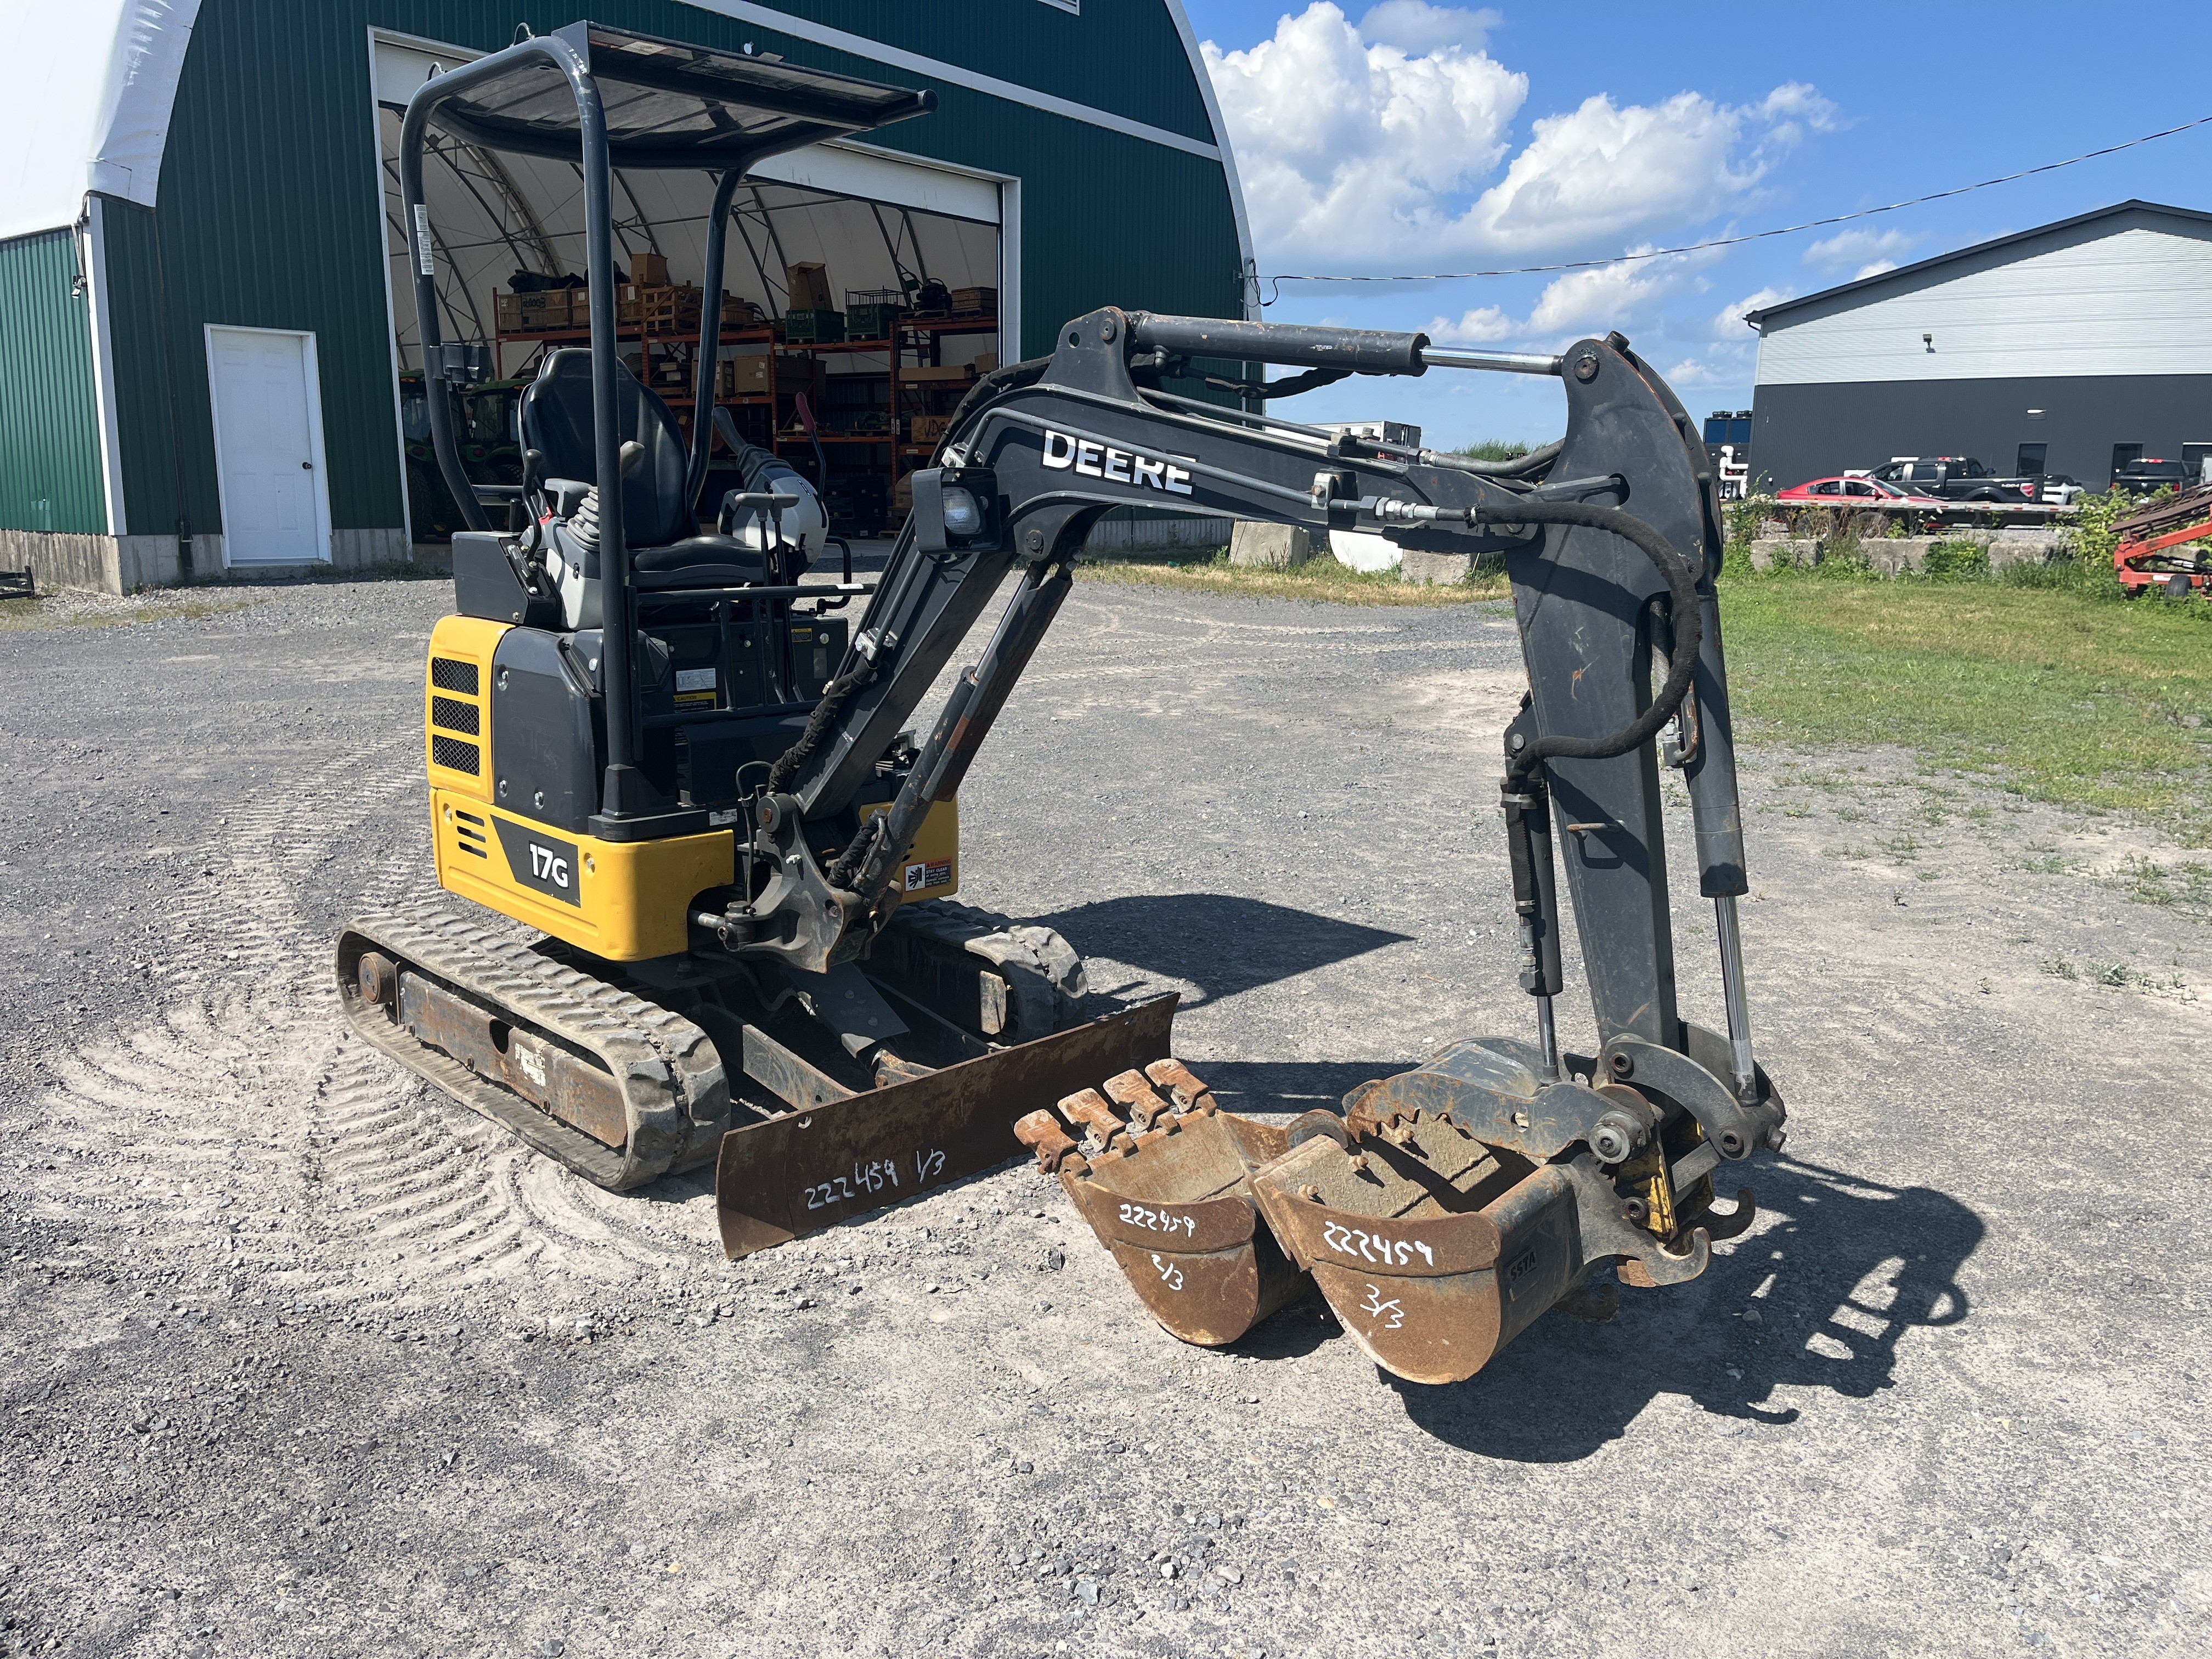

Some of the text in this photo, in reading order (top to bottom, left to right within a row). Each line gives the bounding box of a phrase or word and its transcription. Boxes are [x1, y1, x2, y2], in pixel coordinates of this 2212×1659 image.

[1043, 430, 1196, 495] DEERE
[529, 843, 568, 888] 17G
[930, 859, 951, 867] WARNING
[805, 1148, 946, 1210] 222459 1/3
[1119, 1204, 1195, 1238] 222459
[1323, 1221, 1434, 1267] 222459
[1151, 1254, 1183, 1290] 2/3
[1359, 1283, 1405, 1329] 3/3
